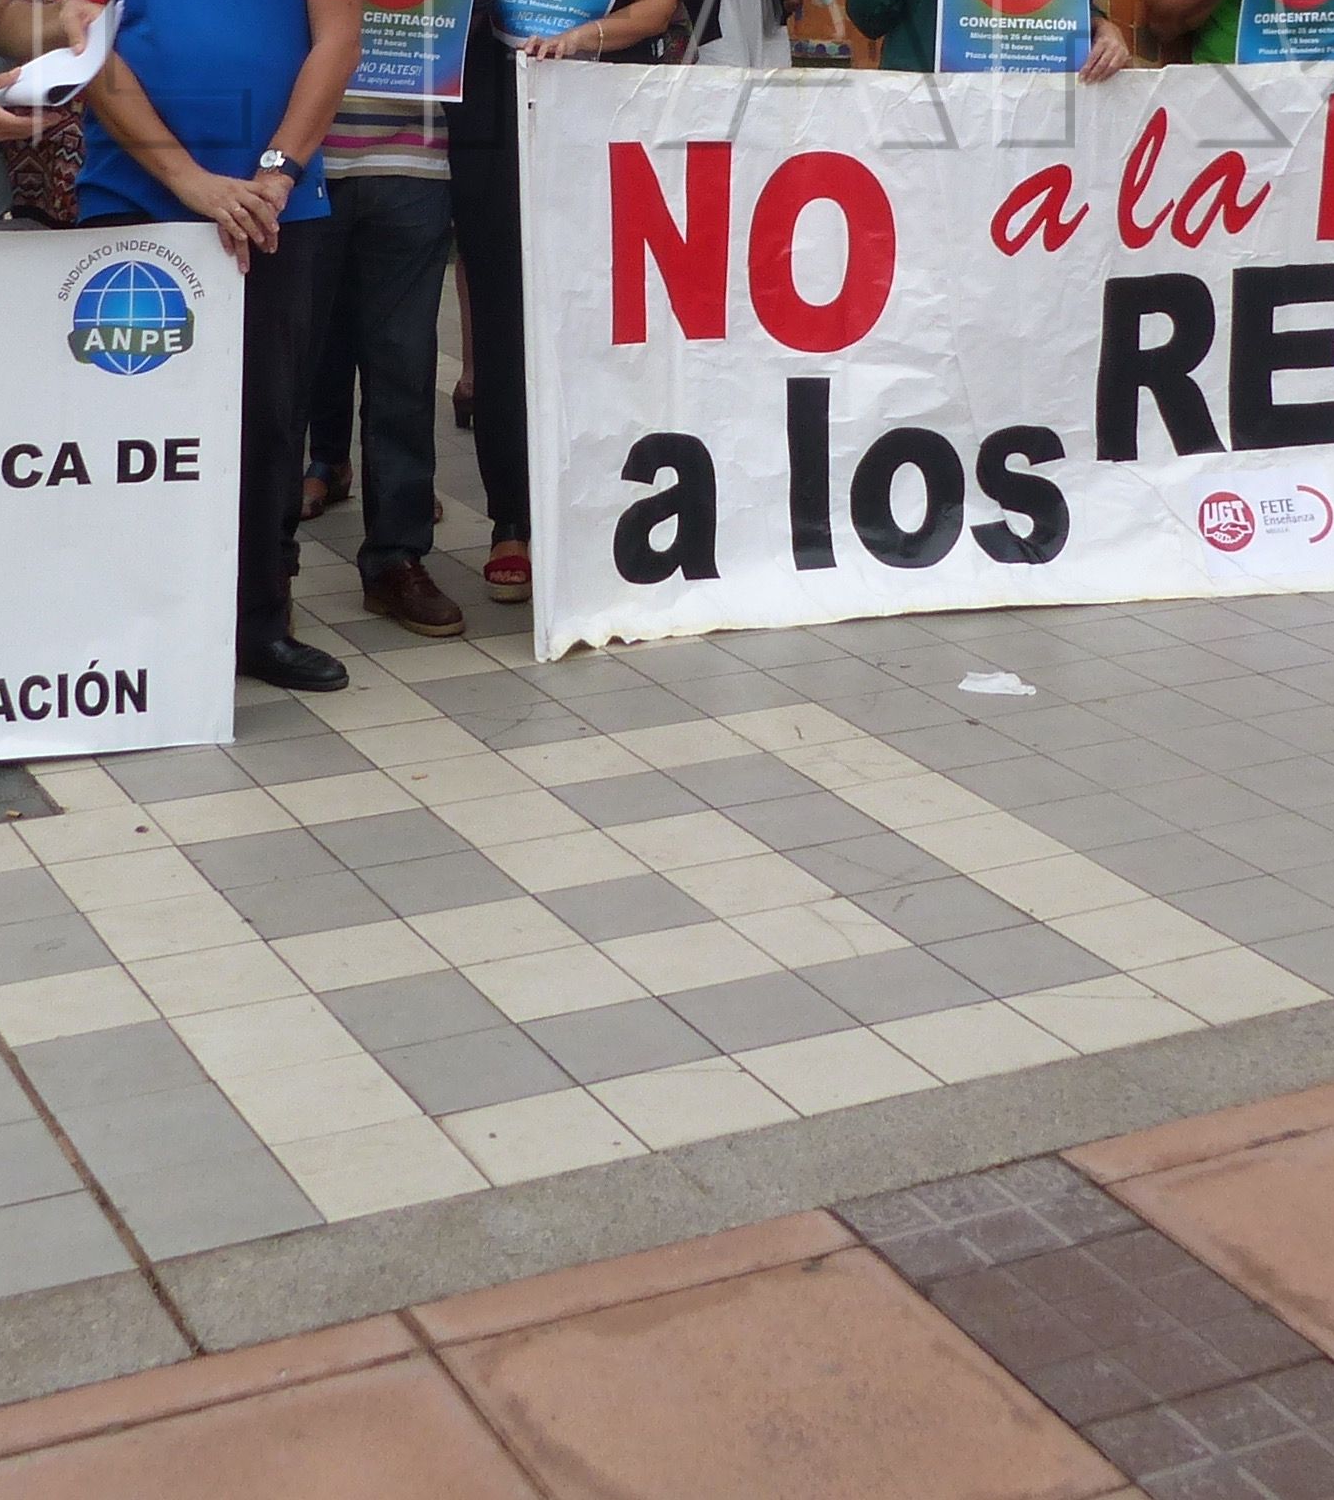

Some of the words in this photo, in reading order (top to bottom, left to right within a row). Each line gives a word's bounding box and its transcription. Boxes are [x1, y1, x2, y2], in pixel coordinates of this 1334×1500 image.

[363, 11, 457, 29] CENTRACIÓN
[959, 16, 1077, 31] CONCENTRACIÓN
[609, 141, 896, 353] NO
[990, 163, 1089, 257] a
[1117, 107, 1272, 249] la
[58, 245, 113, 302] SINDICATO
[116, 239, 205, 300] INDEPENDIENTE
[83, 327, 183, 353] ANPE
[116, 437, 201, 483] DE
[613, 431, 720, 585] a
[786, 377, 1069, 571] los
[1260, 498, 1296, 515] FETE
[1263, 512, 1316, 526] Enseñanza
